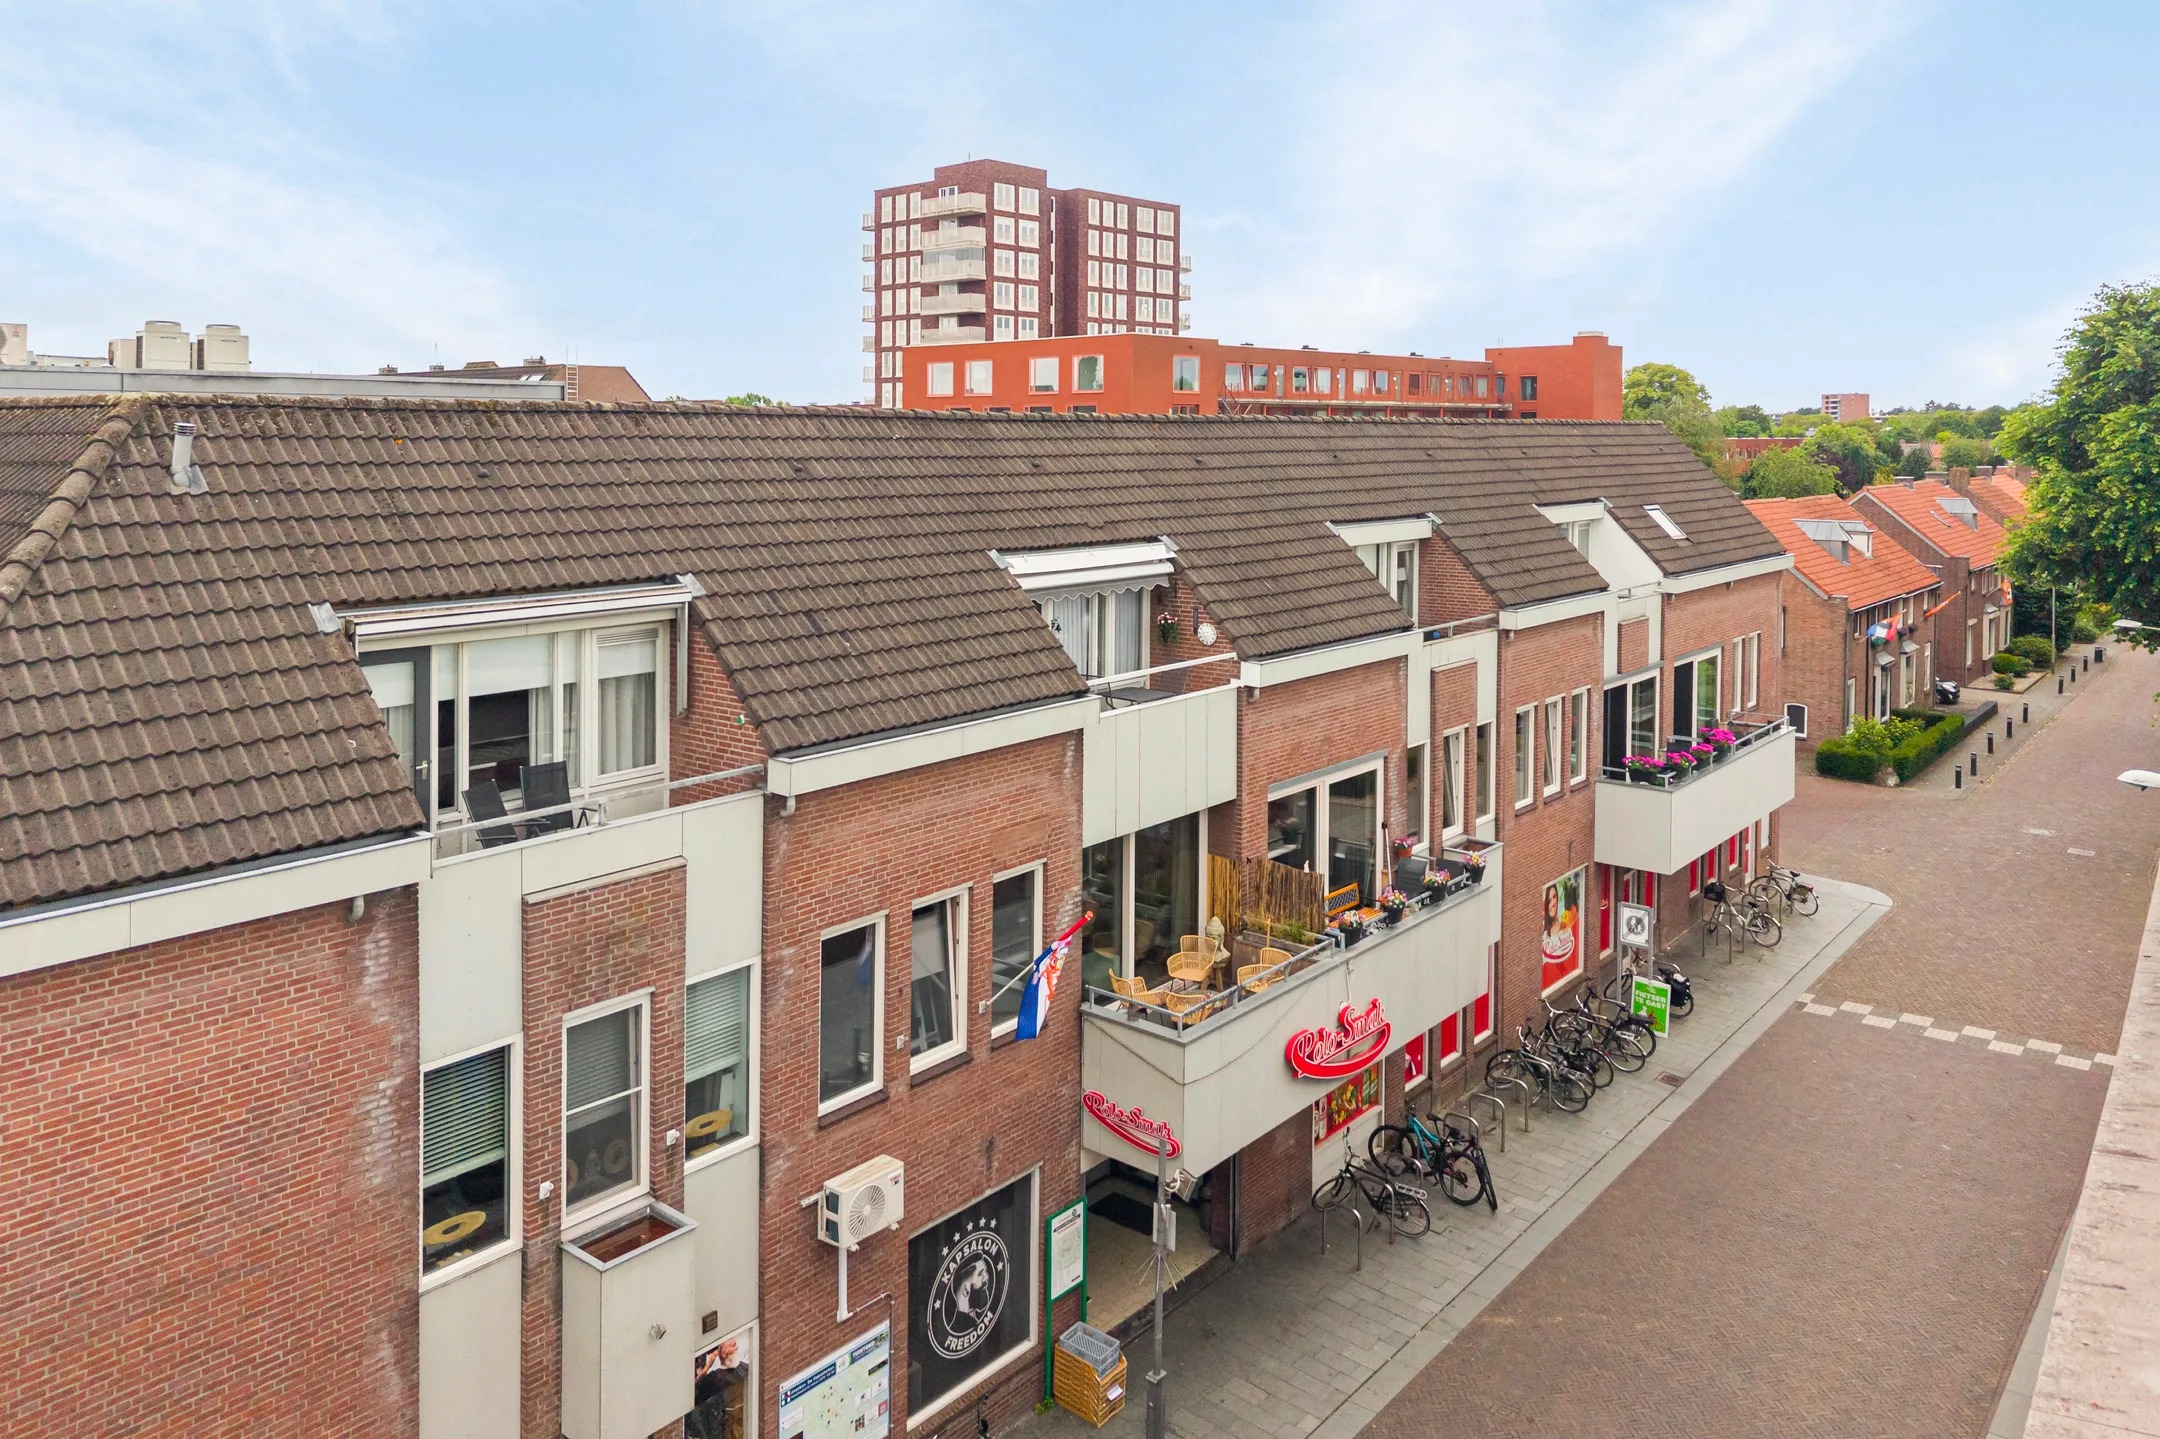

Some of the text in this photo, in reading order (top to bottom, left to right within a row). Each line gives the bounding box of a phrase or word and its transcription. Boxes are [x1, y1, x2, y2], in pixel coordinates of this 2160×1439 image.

[1635, 989, 1666, 1003] FIETSER
[1635, 996, 1666, 1009] TE GAST
[1291, 998, 1387, 1067] Polo-Smak
[1083, 1091, 1173, 1142] Polo-Smak
[941, 1238, 999, 1285] KAPSALON
[944, 1310, 994, 1351] FREEDOM
